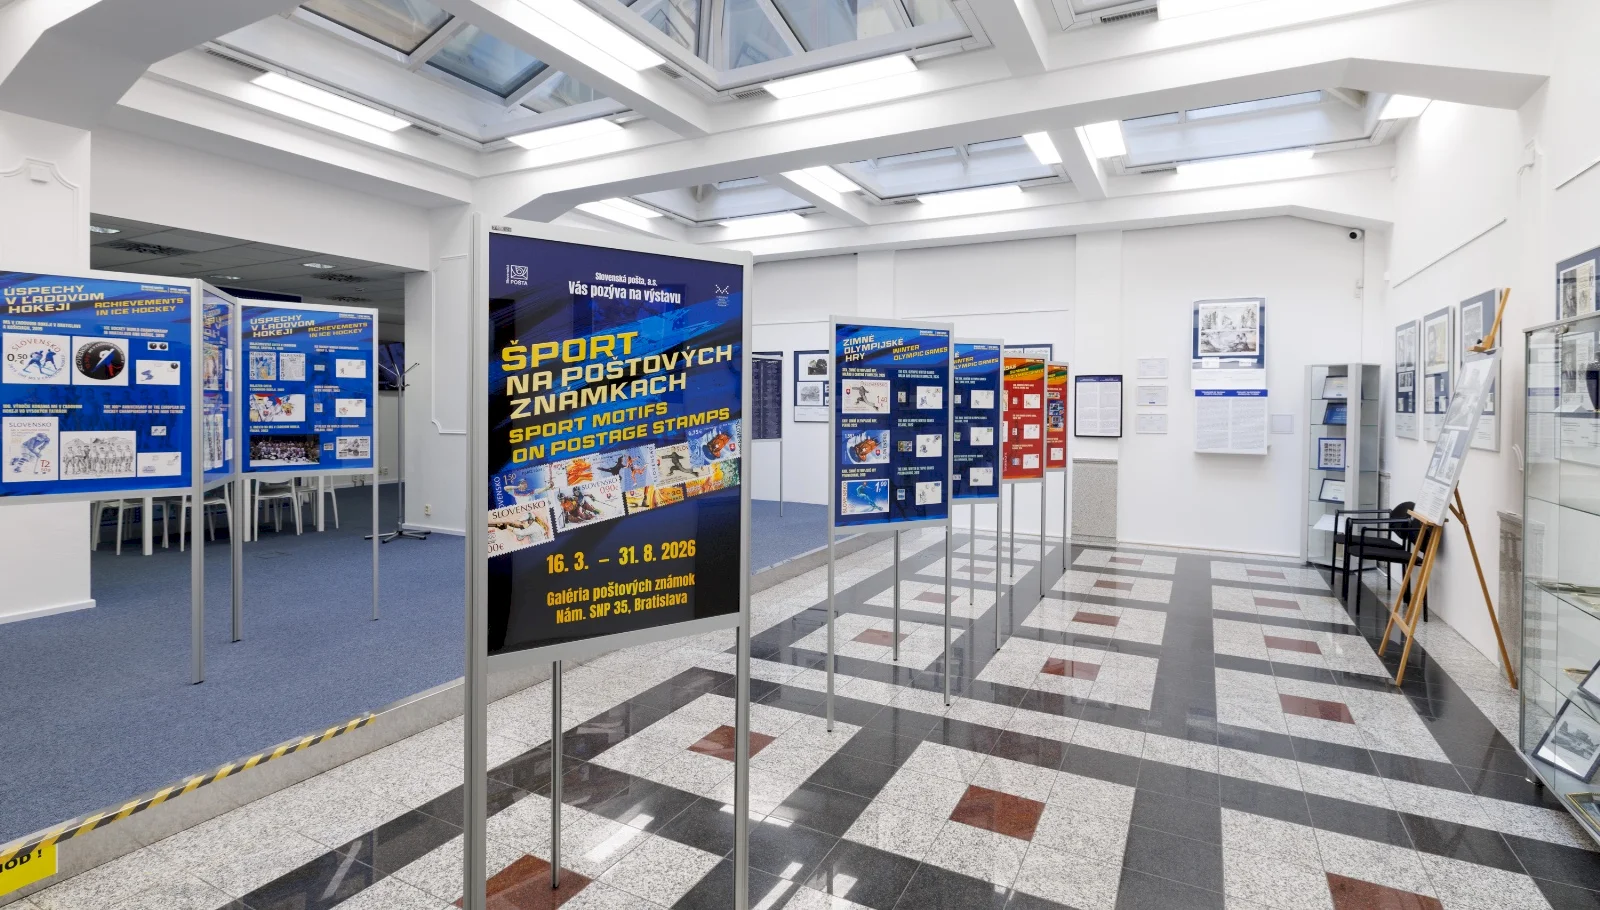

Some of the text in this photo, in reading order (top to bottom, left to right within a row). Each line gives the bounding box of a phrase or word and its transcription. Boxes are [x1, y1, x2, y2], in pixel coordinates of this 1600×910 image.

[595, 272, 658, 287] Slovenská pošta, a.s.
[3, 285, 84, 296] ÚSPECHY
[568, 280, 681, 304] Vás pozýva na výstavu
[5, 292, 104, 305] V ĽADOVOM
[94, 298, 184, 309] ACHIEVEMENTS
[8, 302, 70, 314] HOKEJI
[132, 305, 176, 314] HOCKEY
[250, 314, 302, 325] ÚSPECHY
[261, 320, 315, 331] ĽADOVOM
[253, 328, 293, 338] HOKEJI
[308, 322, 368, 332] ACHIEVEMENTS
[332, 328, 363, 336] HOCKEY
[12, 338, 61, 353] SLOVENSKO
[843, 333, 875, 347] ZIMNÉ
[844, 337, 903, 354] OLYMPIJSKÉ
[501, 331, 638, 372] ŠPORT
[892, 344, 920, 354] WINTER
[893, 346, 948, 361] OLYMPIC GAMES
[845, 352, 865, 363] HRY
[506, 344, 733, 396] NA POŠTOVÝCH
[510, 372, 686, 420] ZNÁMKACH
[509, 401, 668, 444] SPORT MOTIFS
[512, 408, 730, 464] ON POSTAGE STAMPS
[40, 460, 50, 468] T2
[582, 477, 618, 490] SLOVENSKO
[492, 500, 546, 519] SLOVENSKO
[546, 553, 569, 574] 16.
[574, 552, 589, 571] 3.
[618, 546, 639, 566] 31.
[643, 544, 656, 562] 8.
[661, 539, 696, 560] 2026
[546, 572, 696, 606] Galéria poštových známok
[556, 591, 687, 624] Nám. SNP 35, Bratislava
